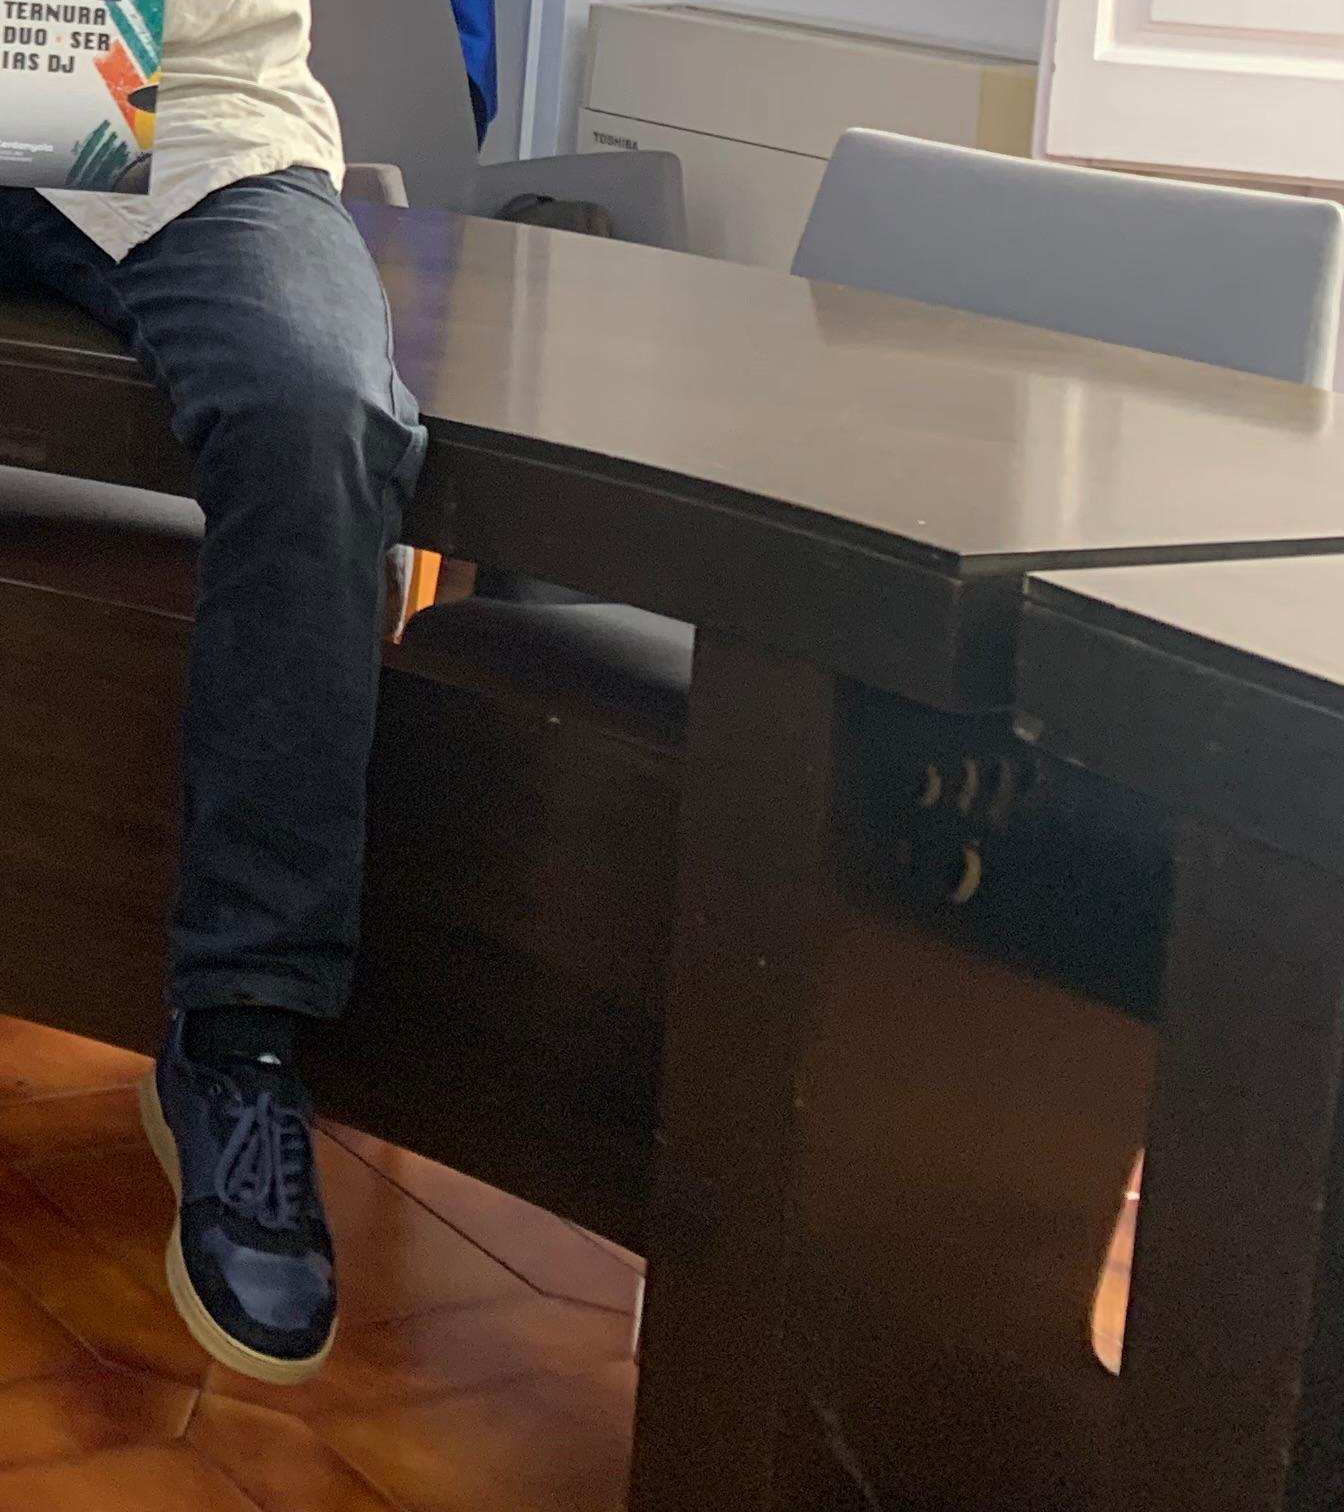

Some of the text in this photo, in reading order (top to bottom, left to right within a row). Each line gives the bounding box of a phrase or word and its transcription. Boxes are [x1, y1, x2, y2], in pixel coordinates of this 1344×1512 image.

[3, 1, 106, 25] TERNURA
[3, 26, 47, 46] DUO
[70, 31, 110, 51] SER
[47, 54, 75, 73] DJ
[593, 131, 639, 151] TOSHIBA
